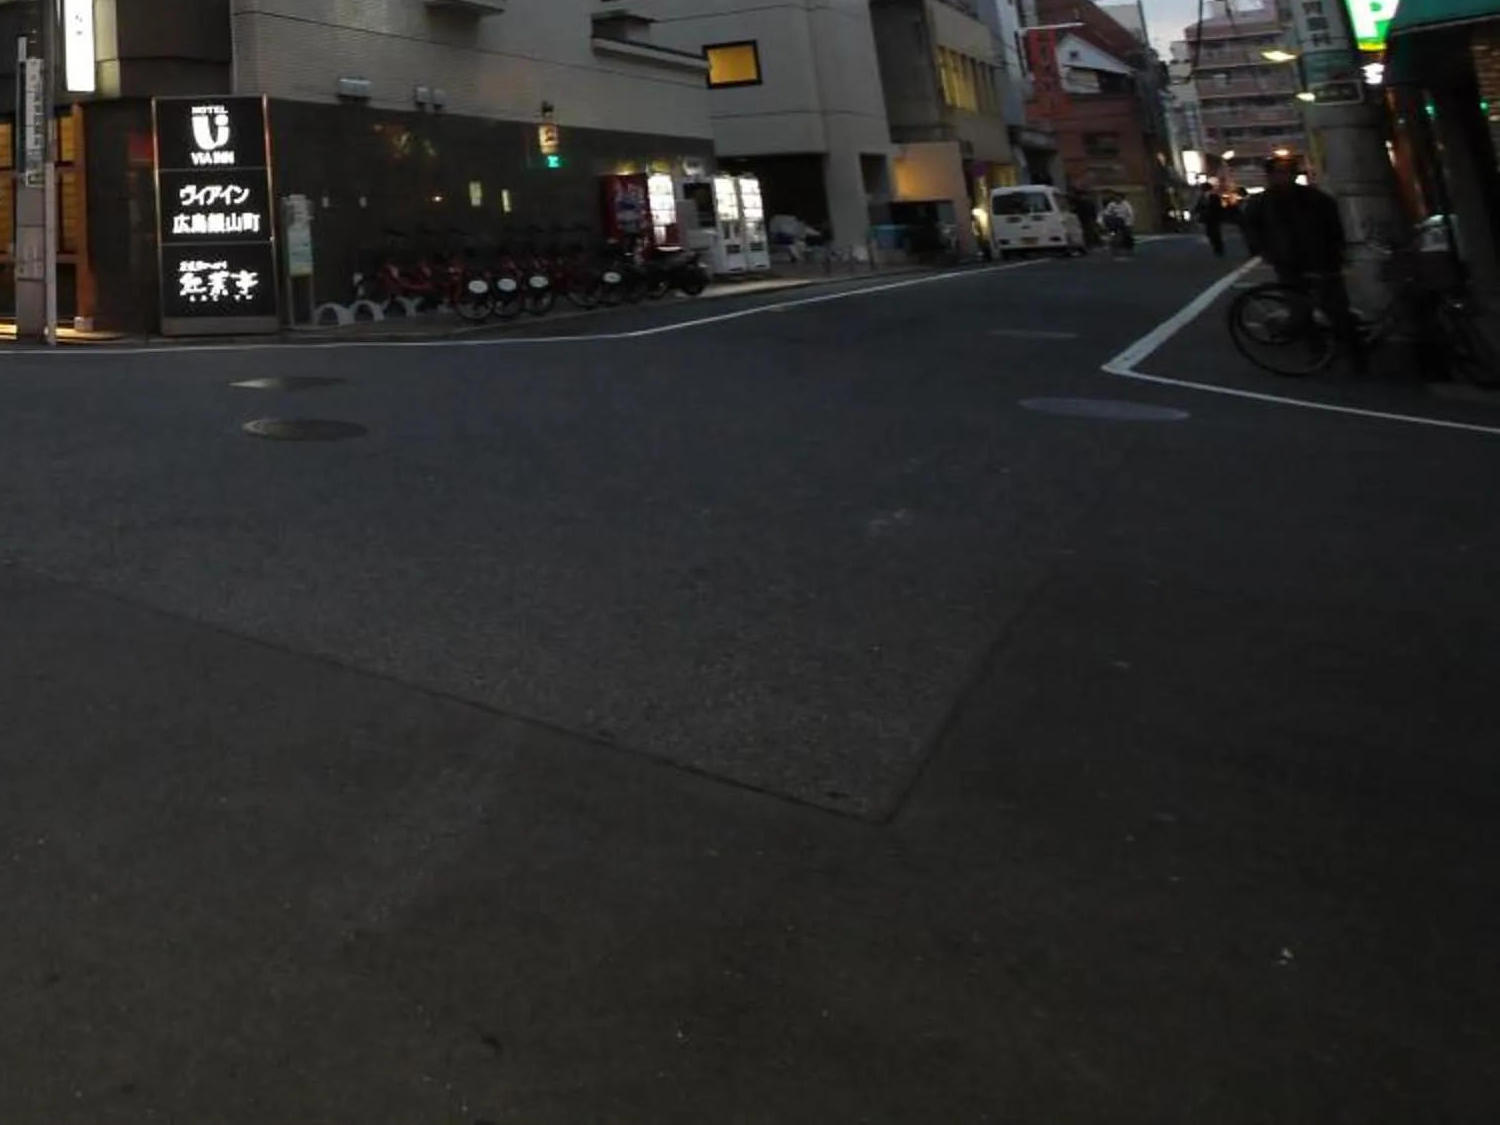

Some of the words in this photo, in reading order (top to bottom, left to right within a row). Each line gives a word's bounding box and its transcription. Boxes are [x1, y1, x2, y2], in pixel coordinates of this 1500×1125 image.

[179, 184, 250, 206] ヴィアイン
